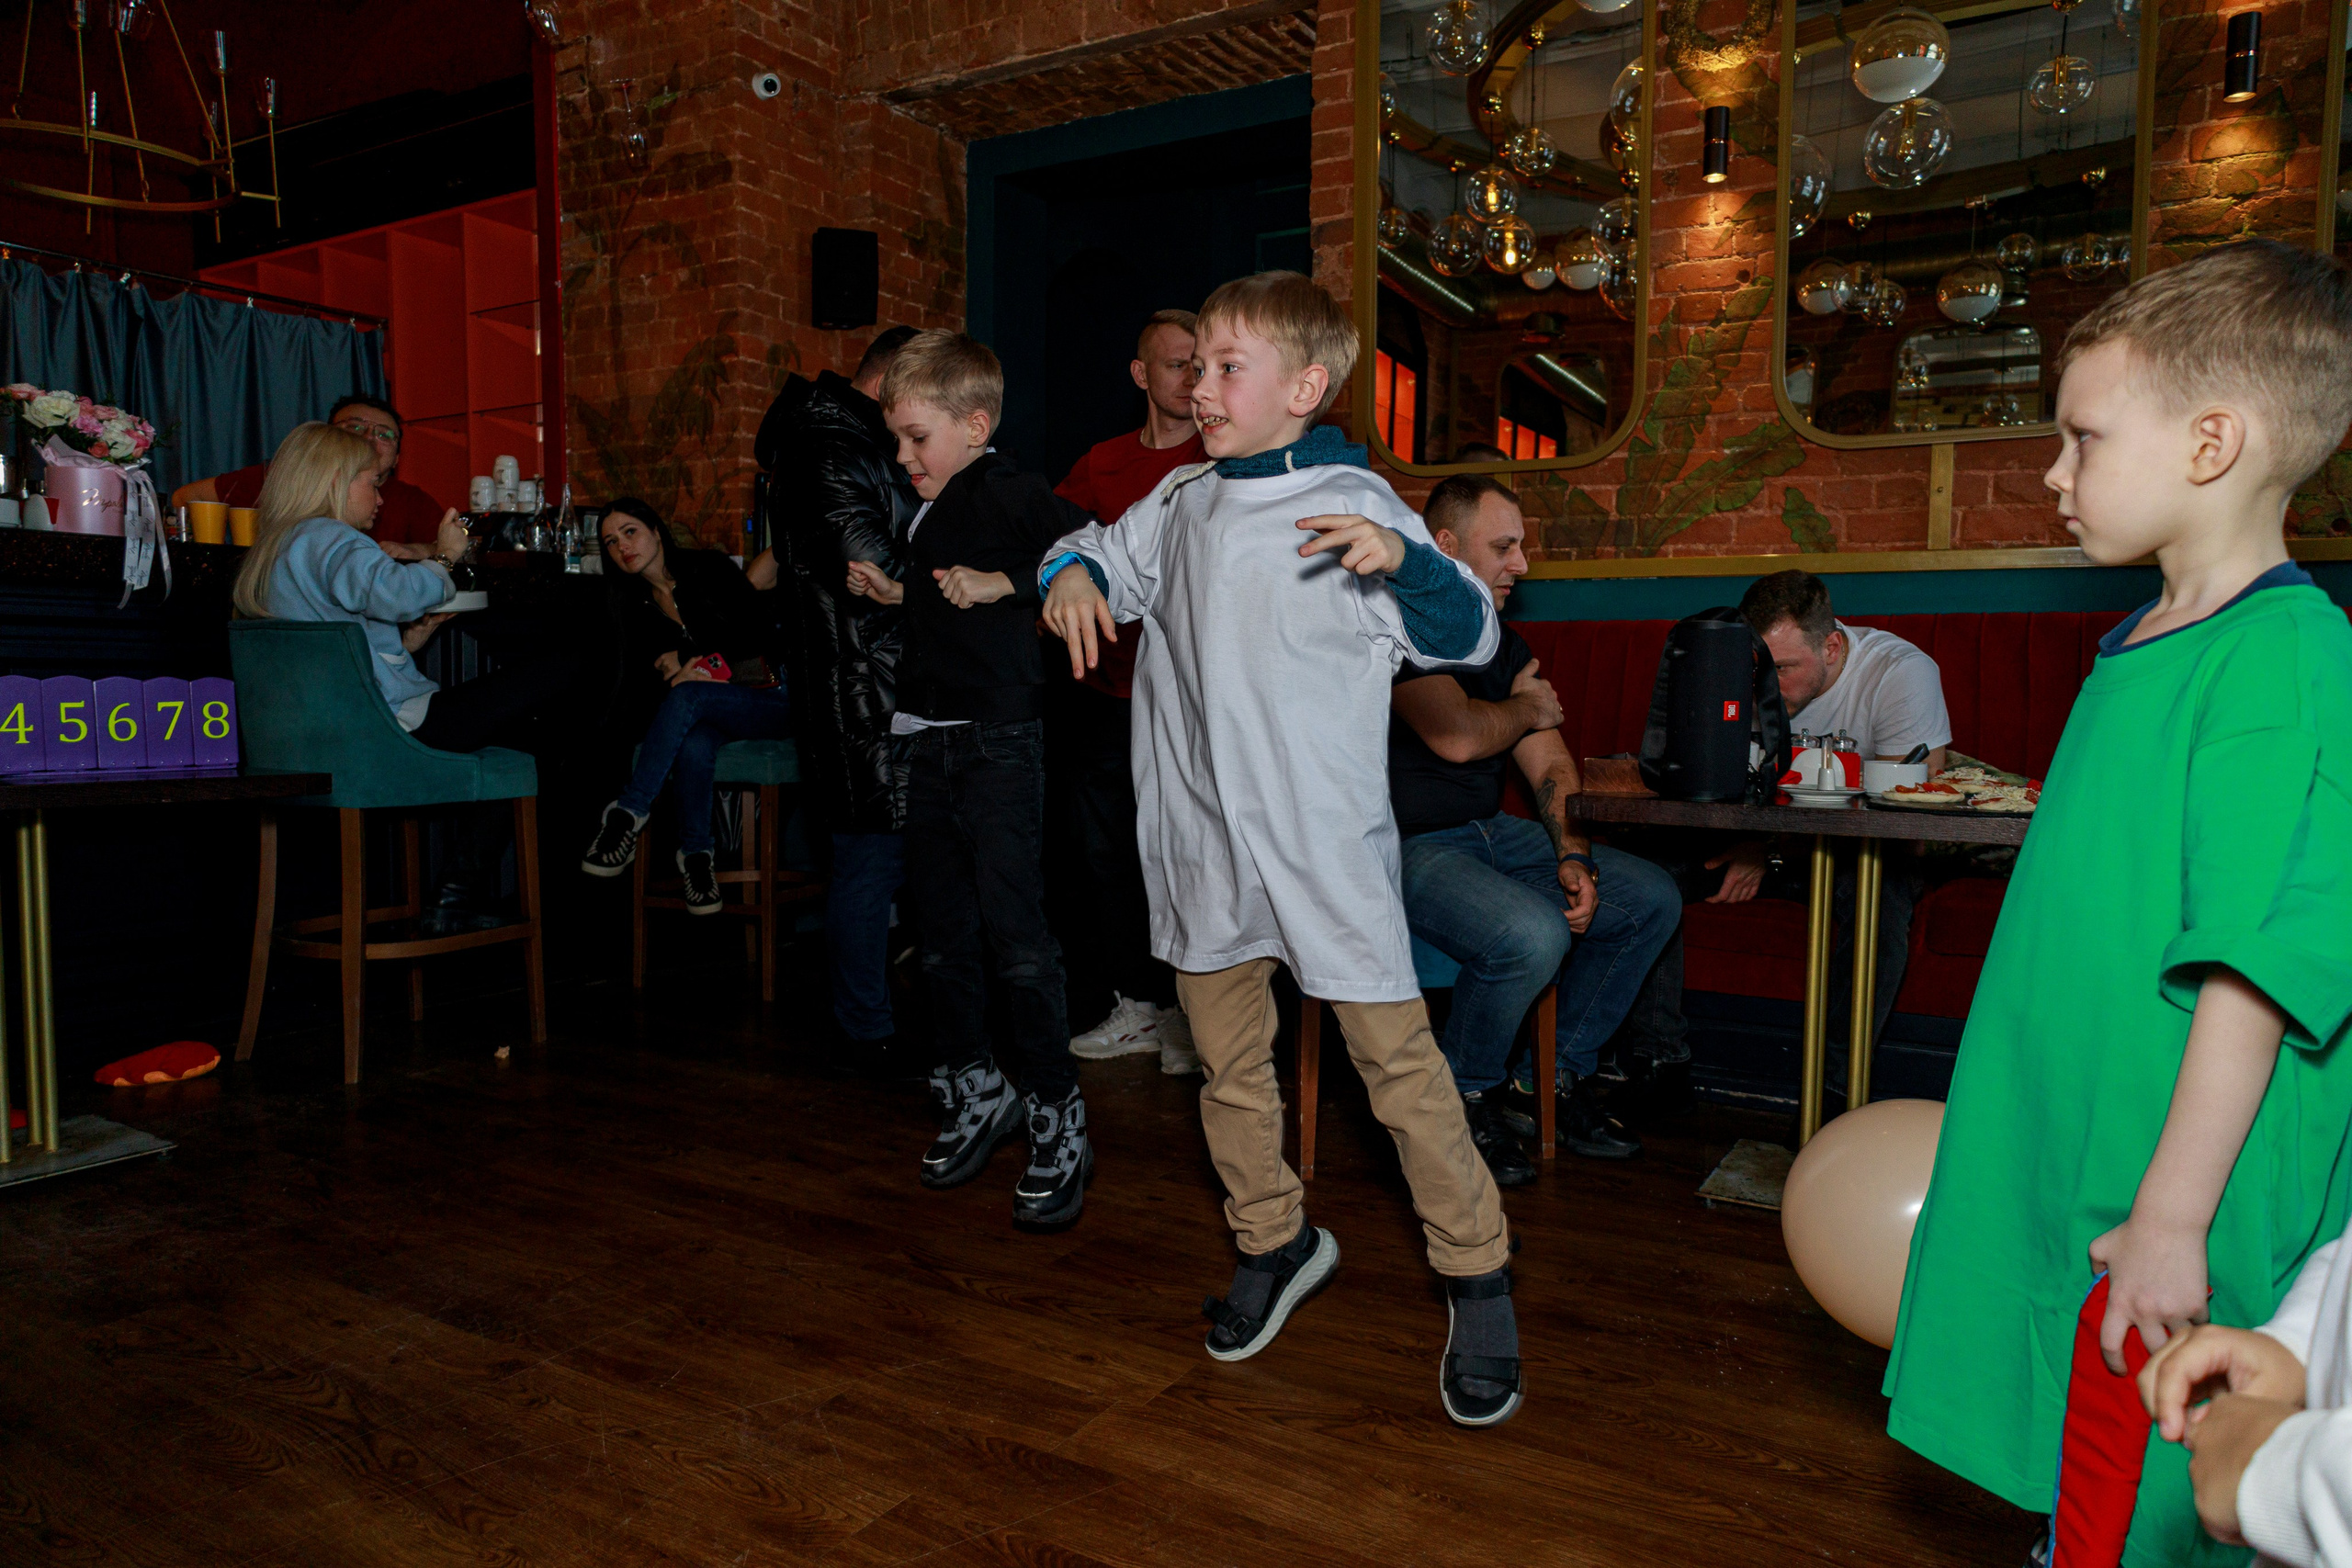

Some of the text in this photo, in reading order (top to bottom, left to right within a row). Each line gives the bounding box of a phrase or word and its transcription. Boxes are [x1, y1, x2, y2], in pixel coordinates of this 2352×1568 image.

[0, 700, 230, 744] 4 5 6 7 8
